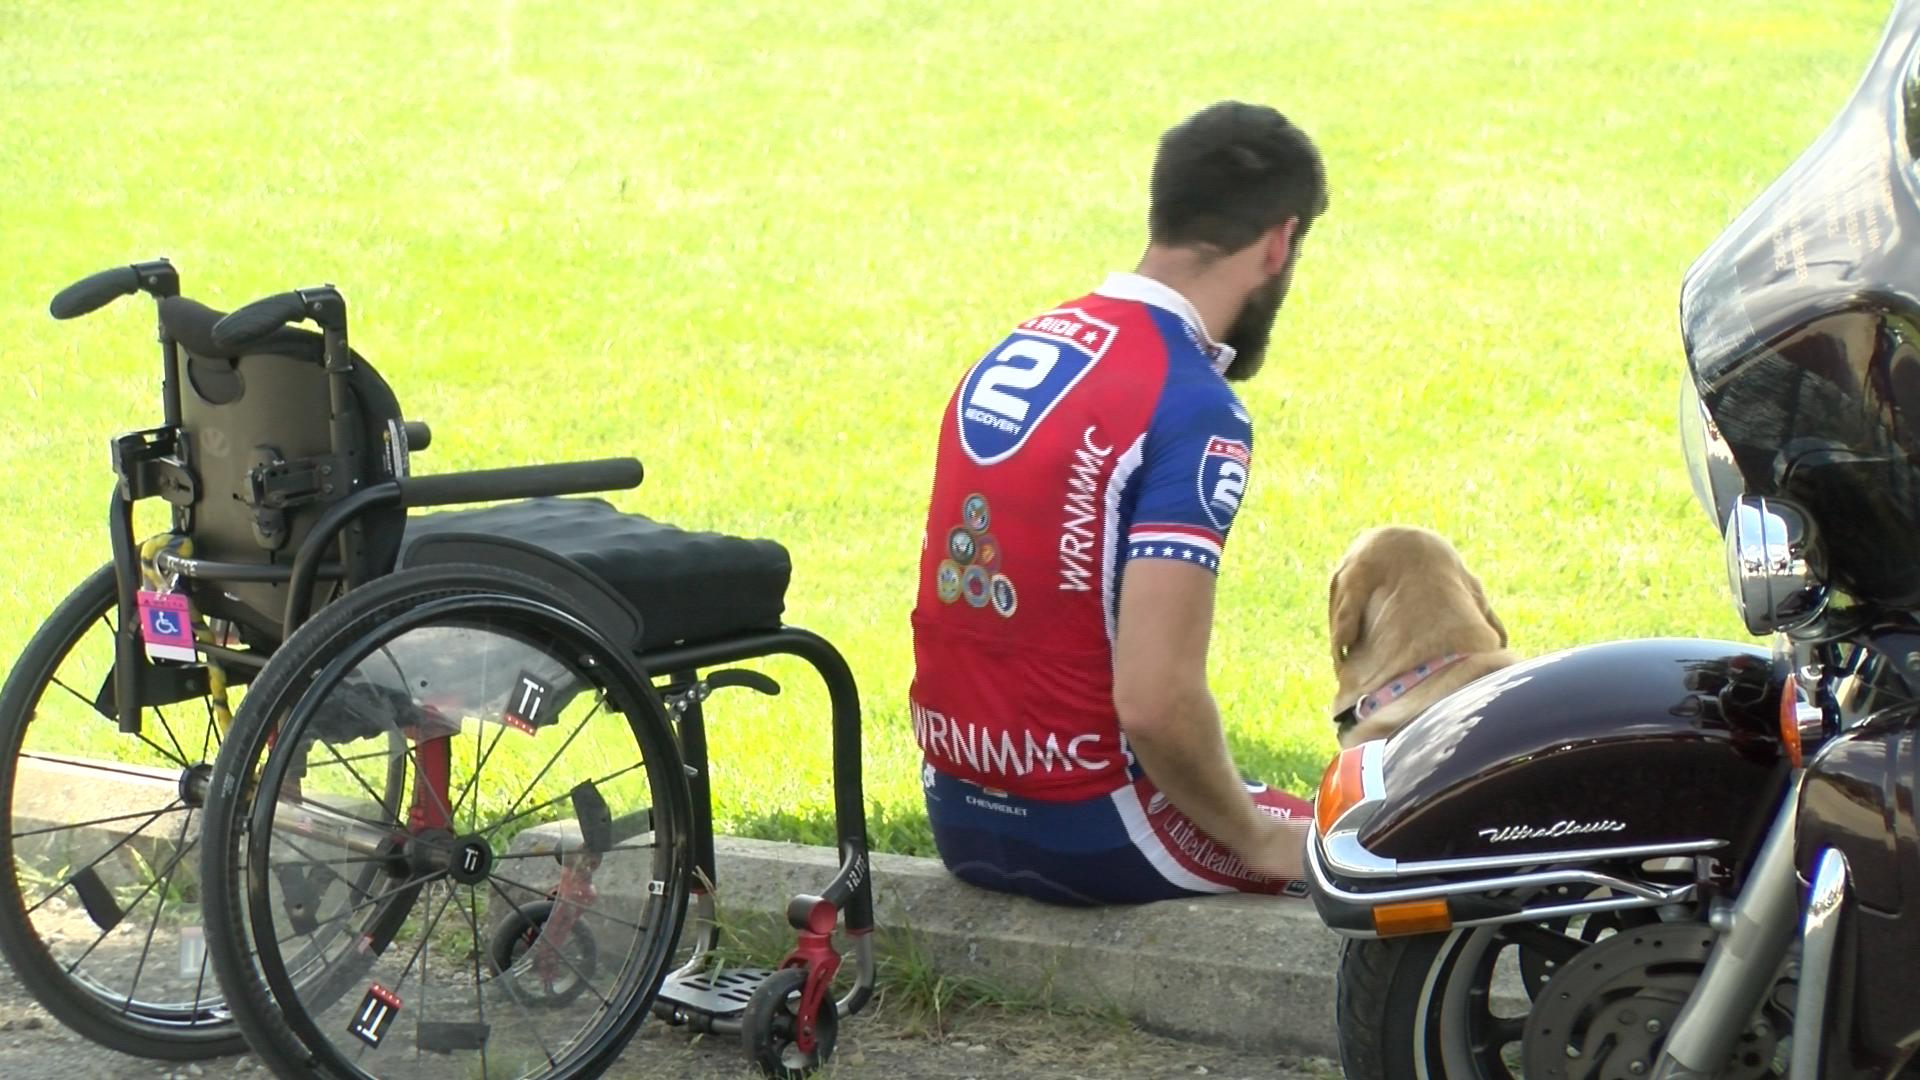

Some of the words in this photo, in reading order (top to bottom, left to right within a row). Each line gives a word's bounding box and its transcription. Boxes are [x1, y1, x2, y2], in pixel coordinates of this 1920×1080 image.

[970, 339, 1060, 422] 2
[1057, 424, 1115, 592] WRNMMC
[1212, 461, 1248, 511] 2
[518, 677, 545, 721] Ti
[910, 700, 1111, 777] WRNMMC
[965, 795, 1028, 818] CHEVROLET
[464, 847, 479, 871] Ti
[356, 998, 389, 1042] Ti
